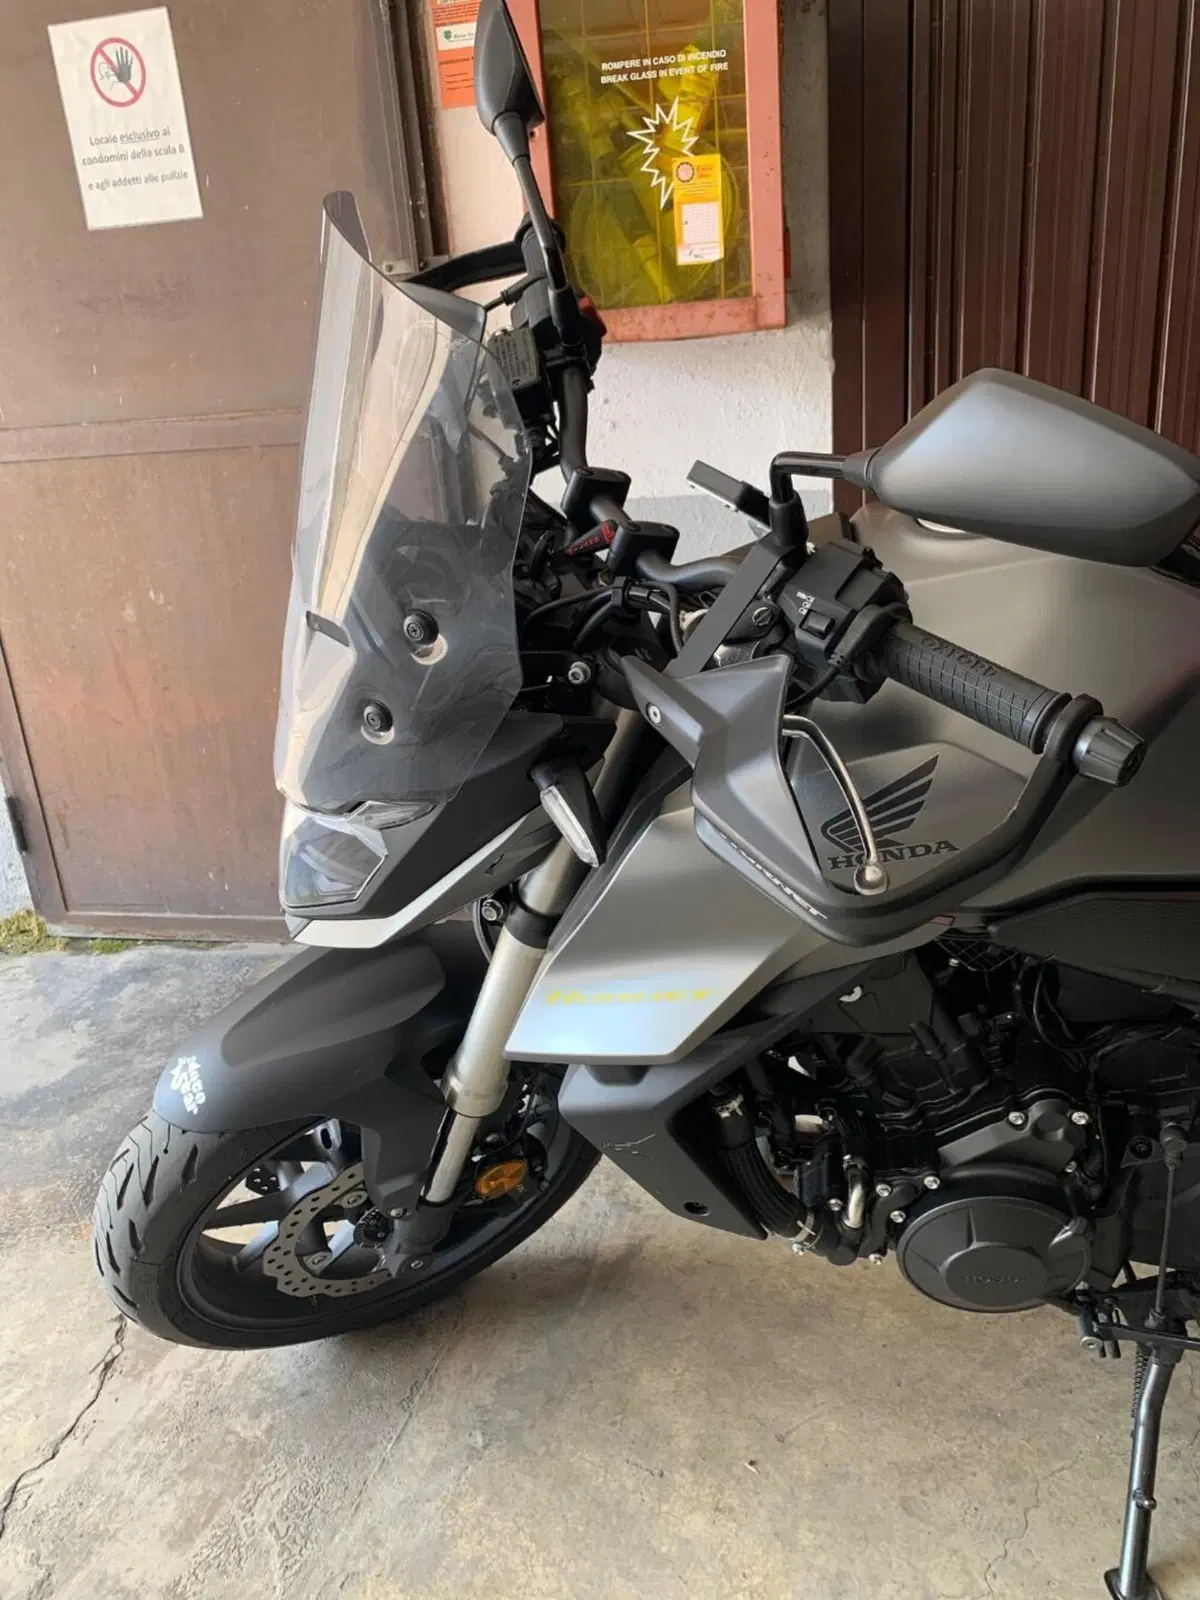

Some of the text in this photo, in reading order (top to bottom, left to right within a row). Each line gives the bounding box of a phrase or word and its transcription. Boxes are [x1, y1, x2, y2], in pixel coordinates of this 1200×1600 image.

[601, 49, 727, 71] ROMPERE IN CASO DI INCENDIO
[601, 62, 729, 84] BREAK GLASS IN EVENT OF FIRE
[89, 126, 171, 146] Locale esclusivo ai
[82, 151, 129, 165] condomini
[130, 148, 153, 160] della
[154, 145, 177, 157] scala
[95, 179, 110, 191] agli
[111, 175, 142, 188] addetti
[143, 173, 159, 183] alle
[160, 169, 189, 183] pulizie
